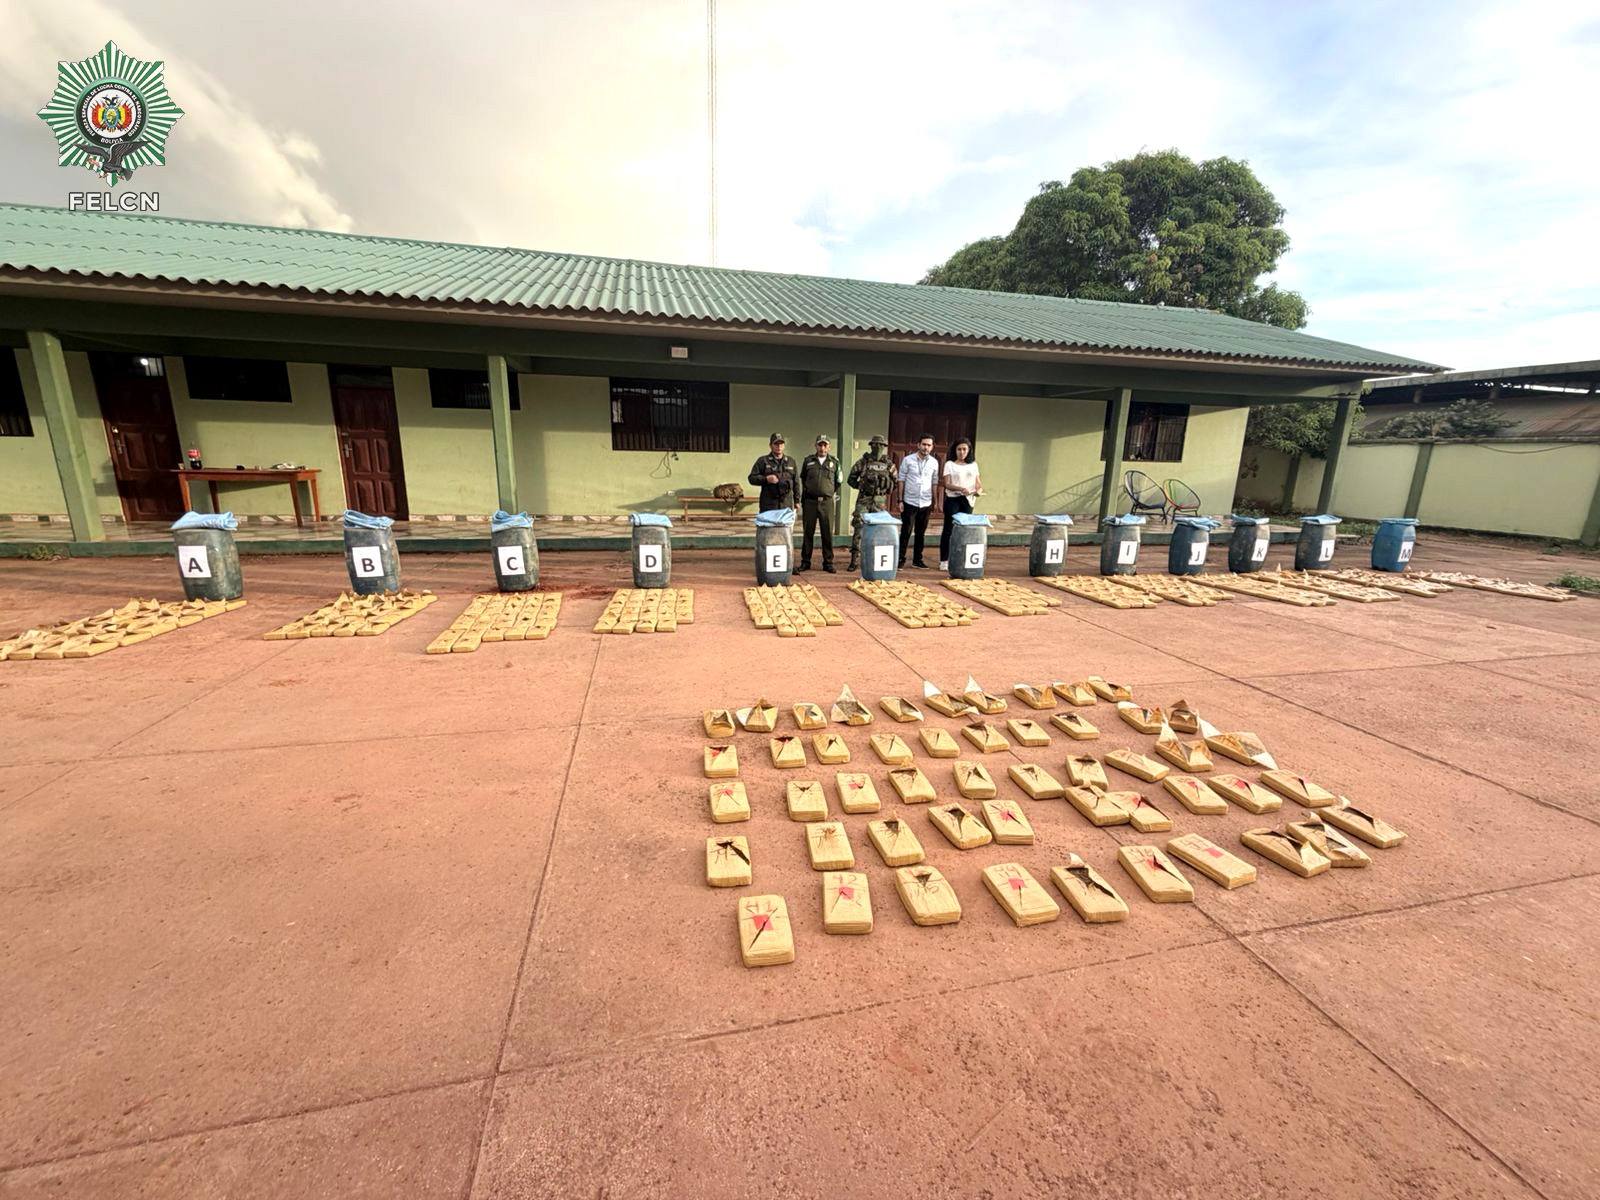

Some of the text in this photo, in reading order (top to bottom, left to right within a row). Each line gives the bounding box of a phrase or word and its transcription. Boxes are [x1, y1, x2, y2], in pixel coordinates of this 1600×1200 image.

[1050, 548, 1059, 560] H
[1256, 547, 1264, 558] K
[1401, 549, 1411, 560] M
[188, 557, 203, 573] A
[361, 557, 375, 573] B
[506, 556, 518, 571] C
[645, 555, 657, 568] D
[773, 555, 781, 568] E
[880, 555, 888, 567] F
[970, 553, 979, 565] G
